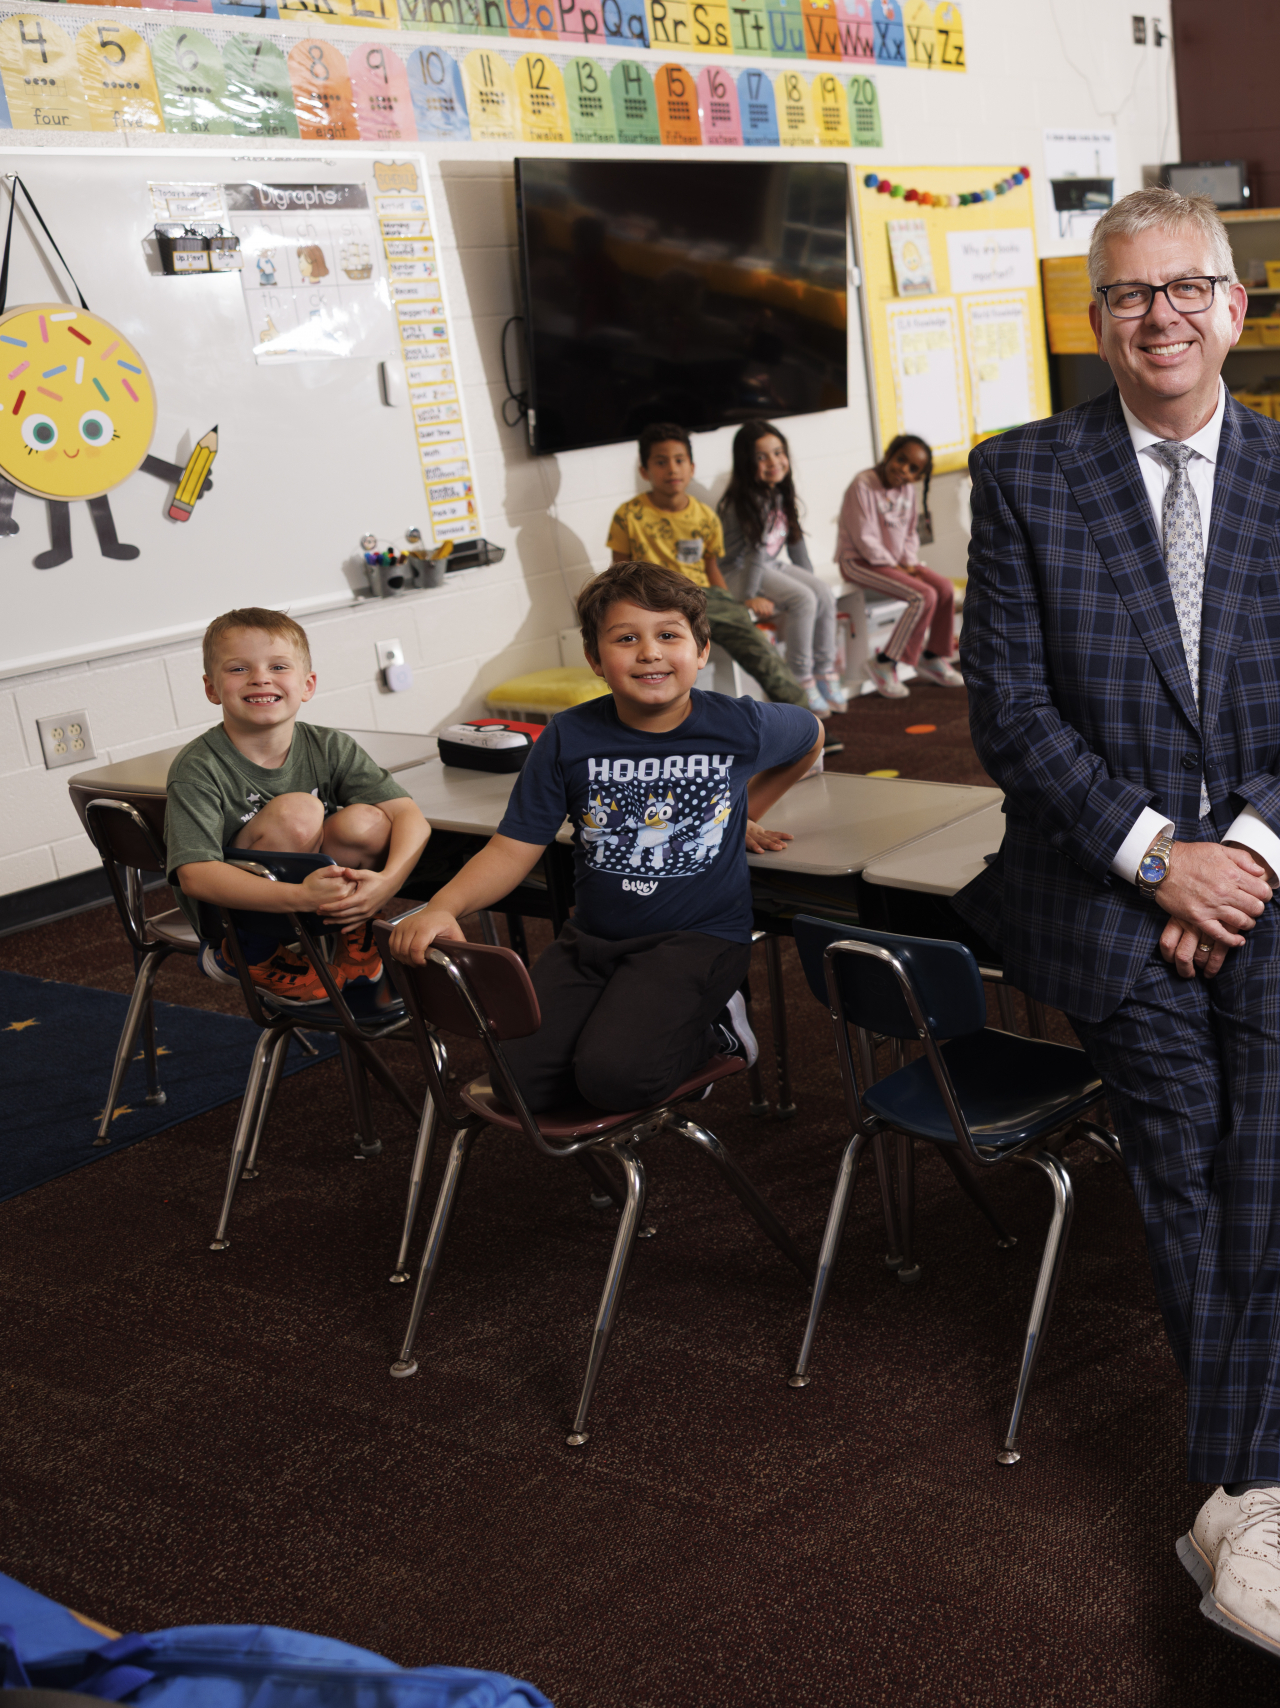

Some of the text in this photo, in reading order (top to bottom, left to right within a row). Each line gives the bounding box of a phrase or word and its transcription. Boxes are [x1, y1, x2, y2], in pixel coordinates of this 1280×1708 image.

[507, 0, 554, 31] Oo
[558, 0, 598, 43] Pp
[602, 0, 650, 48] Qq
[651, 0, 687, 42] Rr
[694, 5, 728, 47] Ss
[732, 8, 764, 50] Tt
[768, 11, 804, 52] Uu
[806, 15, 837, 54] Vv
[839, 22, 874, 57] Ww
[875, 21, 905, 60] Xx
[906, 25, 935, 69] Yy
[938, 29, 964, 66] Zz
[19, 20, 875, 106] 4 5 6 7 8 9 10 11 12 13 14 15 16 17 18 19 20
[33, 108, 70, 126] four
[113, 110, 143, 128] five
[191, 120, 210, 132] six
[316, 124, 347, 140] eight
[377, 127, 402, 139] nine
[480, 126, 515, 139] eleven
[530, 126, 564, 141] twelve
[574, 130, 615, 143] thirteen
[619, 130, 659, 143] fourteen
[667, 130, 698, 143] fifteen
[378, 173, 416, 186] SCHEDULE
[259, 186, 338, 210] Digraphs
[296, 219, 318, 237] ch
[341, 219, 363, 237] sh
[176, 254, 185, 263] Up
[588, 755, 734, 782] HOORAY
[622, 878, 659, 896] BLUEY
